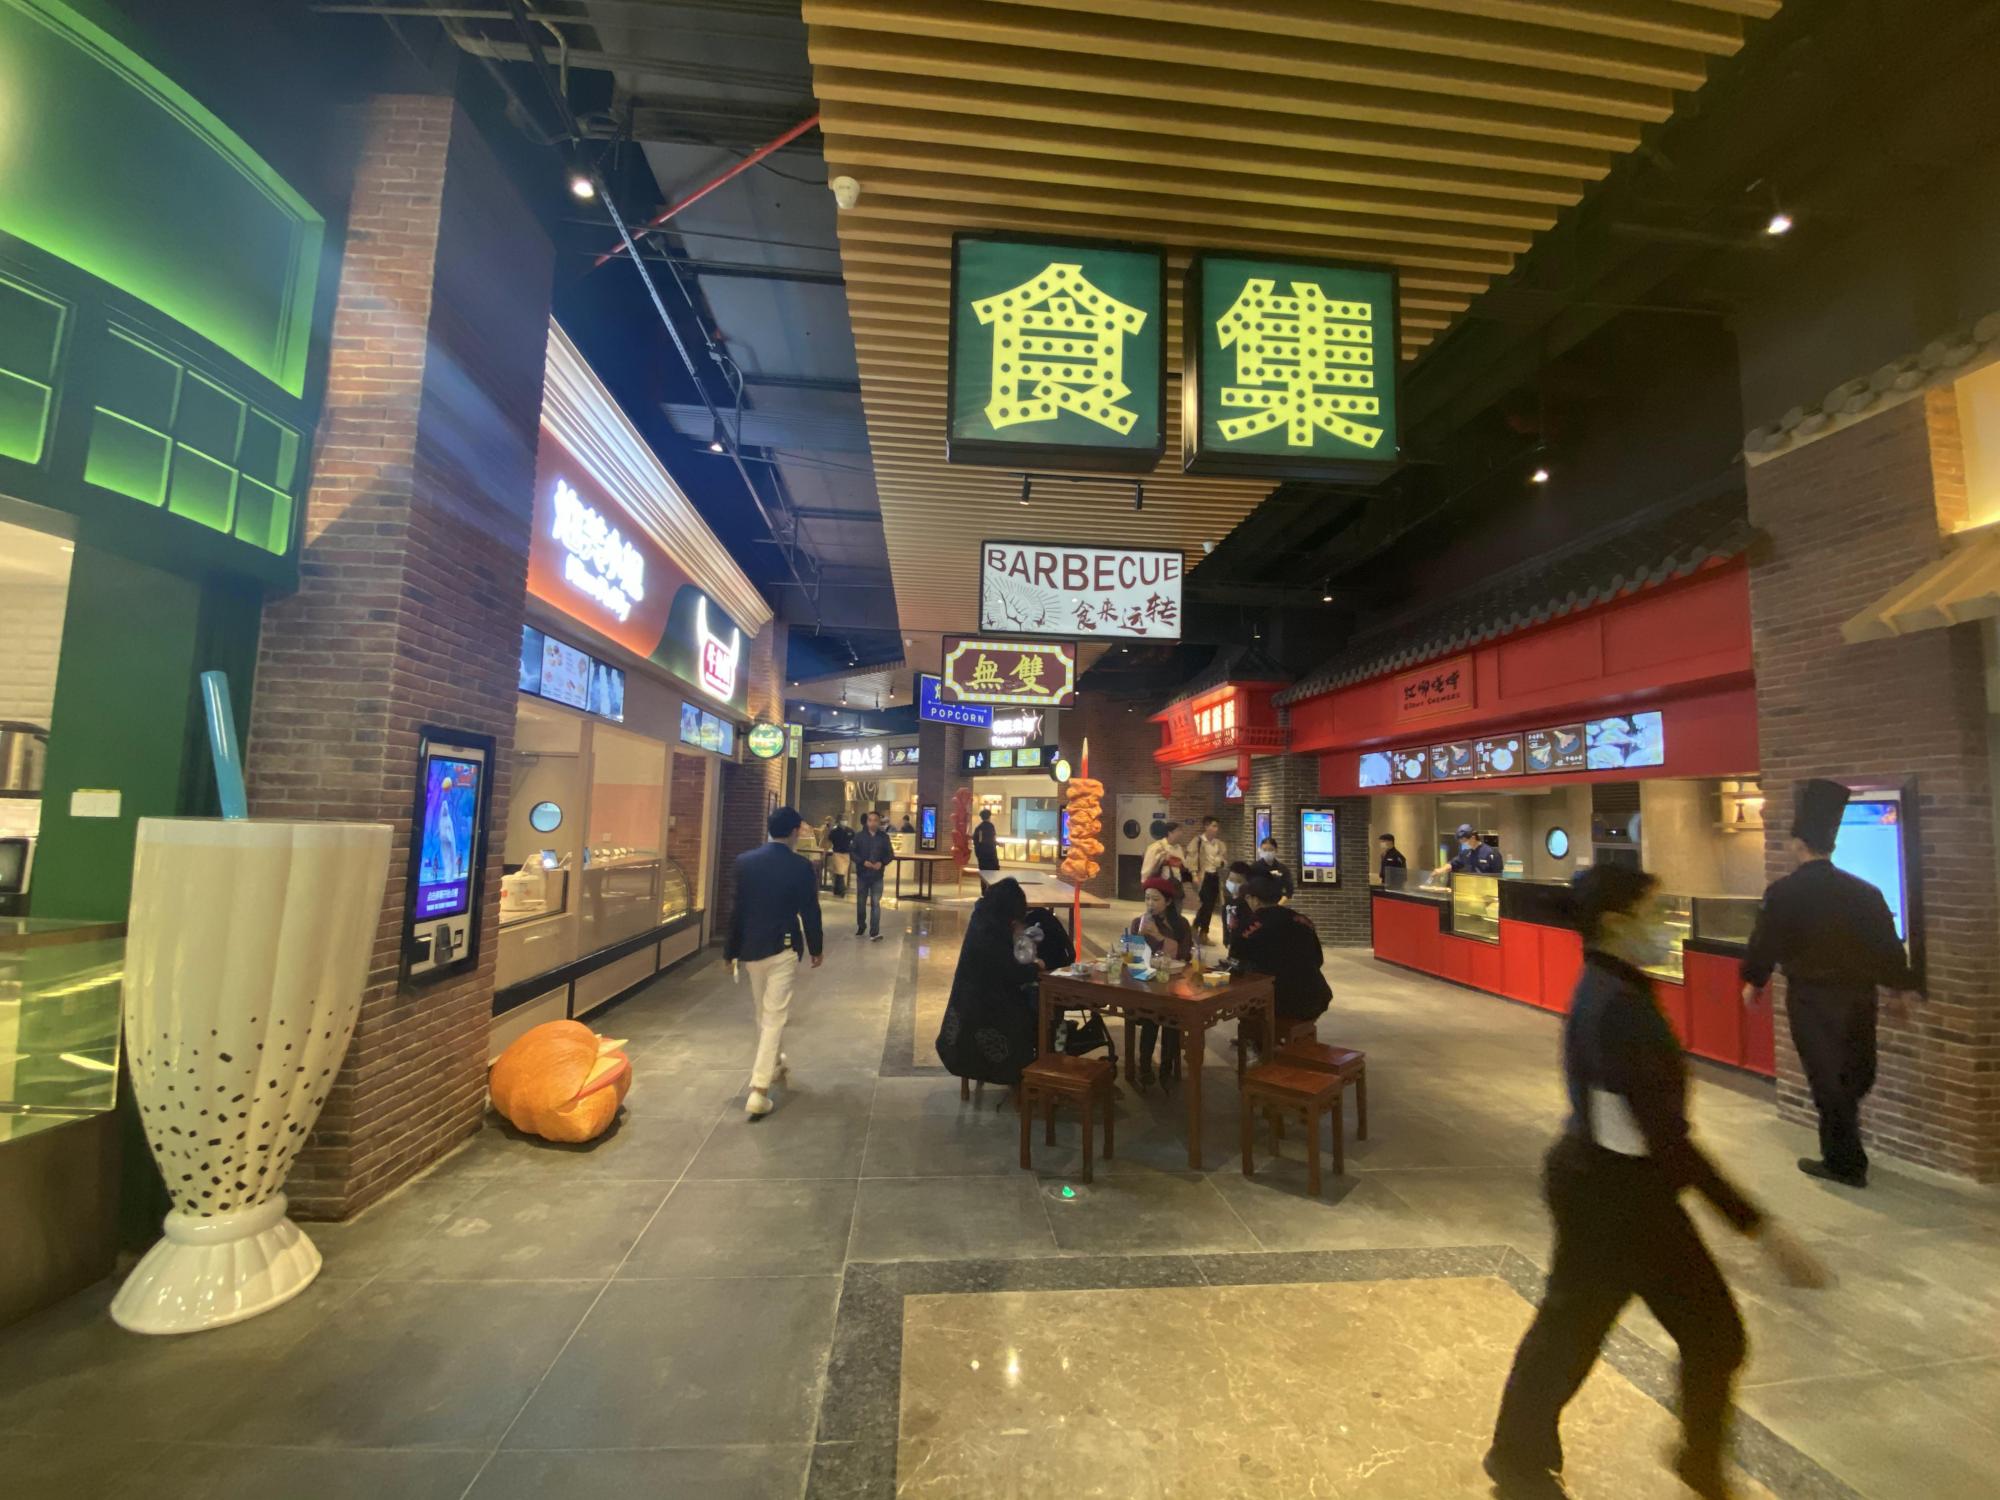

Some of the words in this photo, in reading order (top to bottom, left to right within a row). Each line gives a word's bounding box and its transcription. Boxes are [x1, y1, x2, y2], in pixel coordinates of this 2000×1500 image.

[987, 549, 1180, 592] BARBECUE
[1071, 592, 1178, 635] 食来运转
[965, 653, 1050, 694] 無雙
[931, 707, 985, 724] POPCORN
